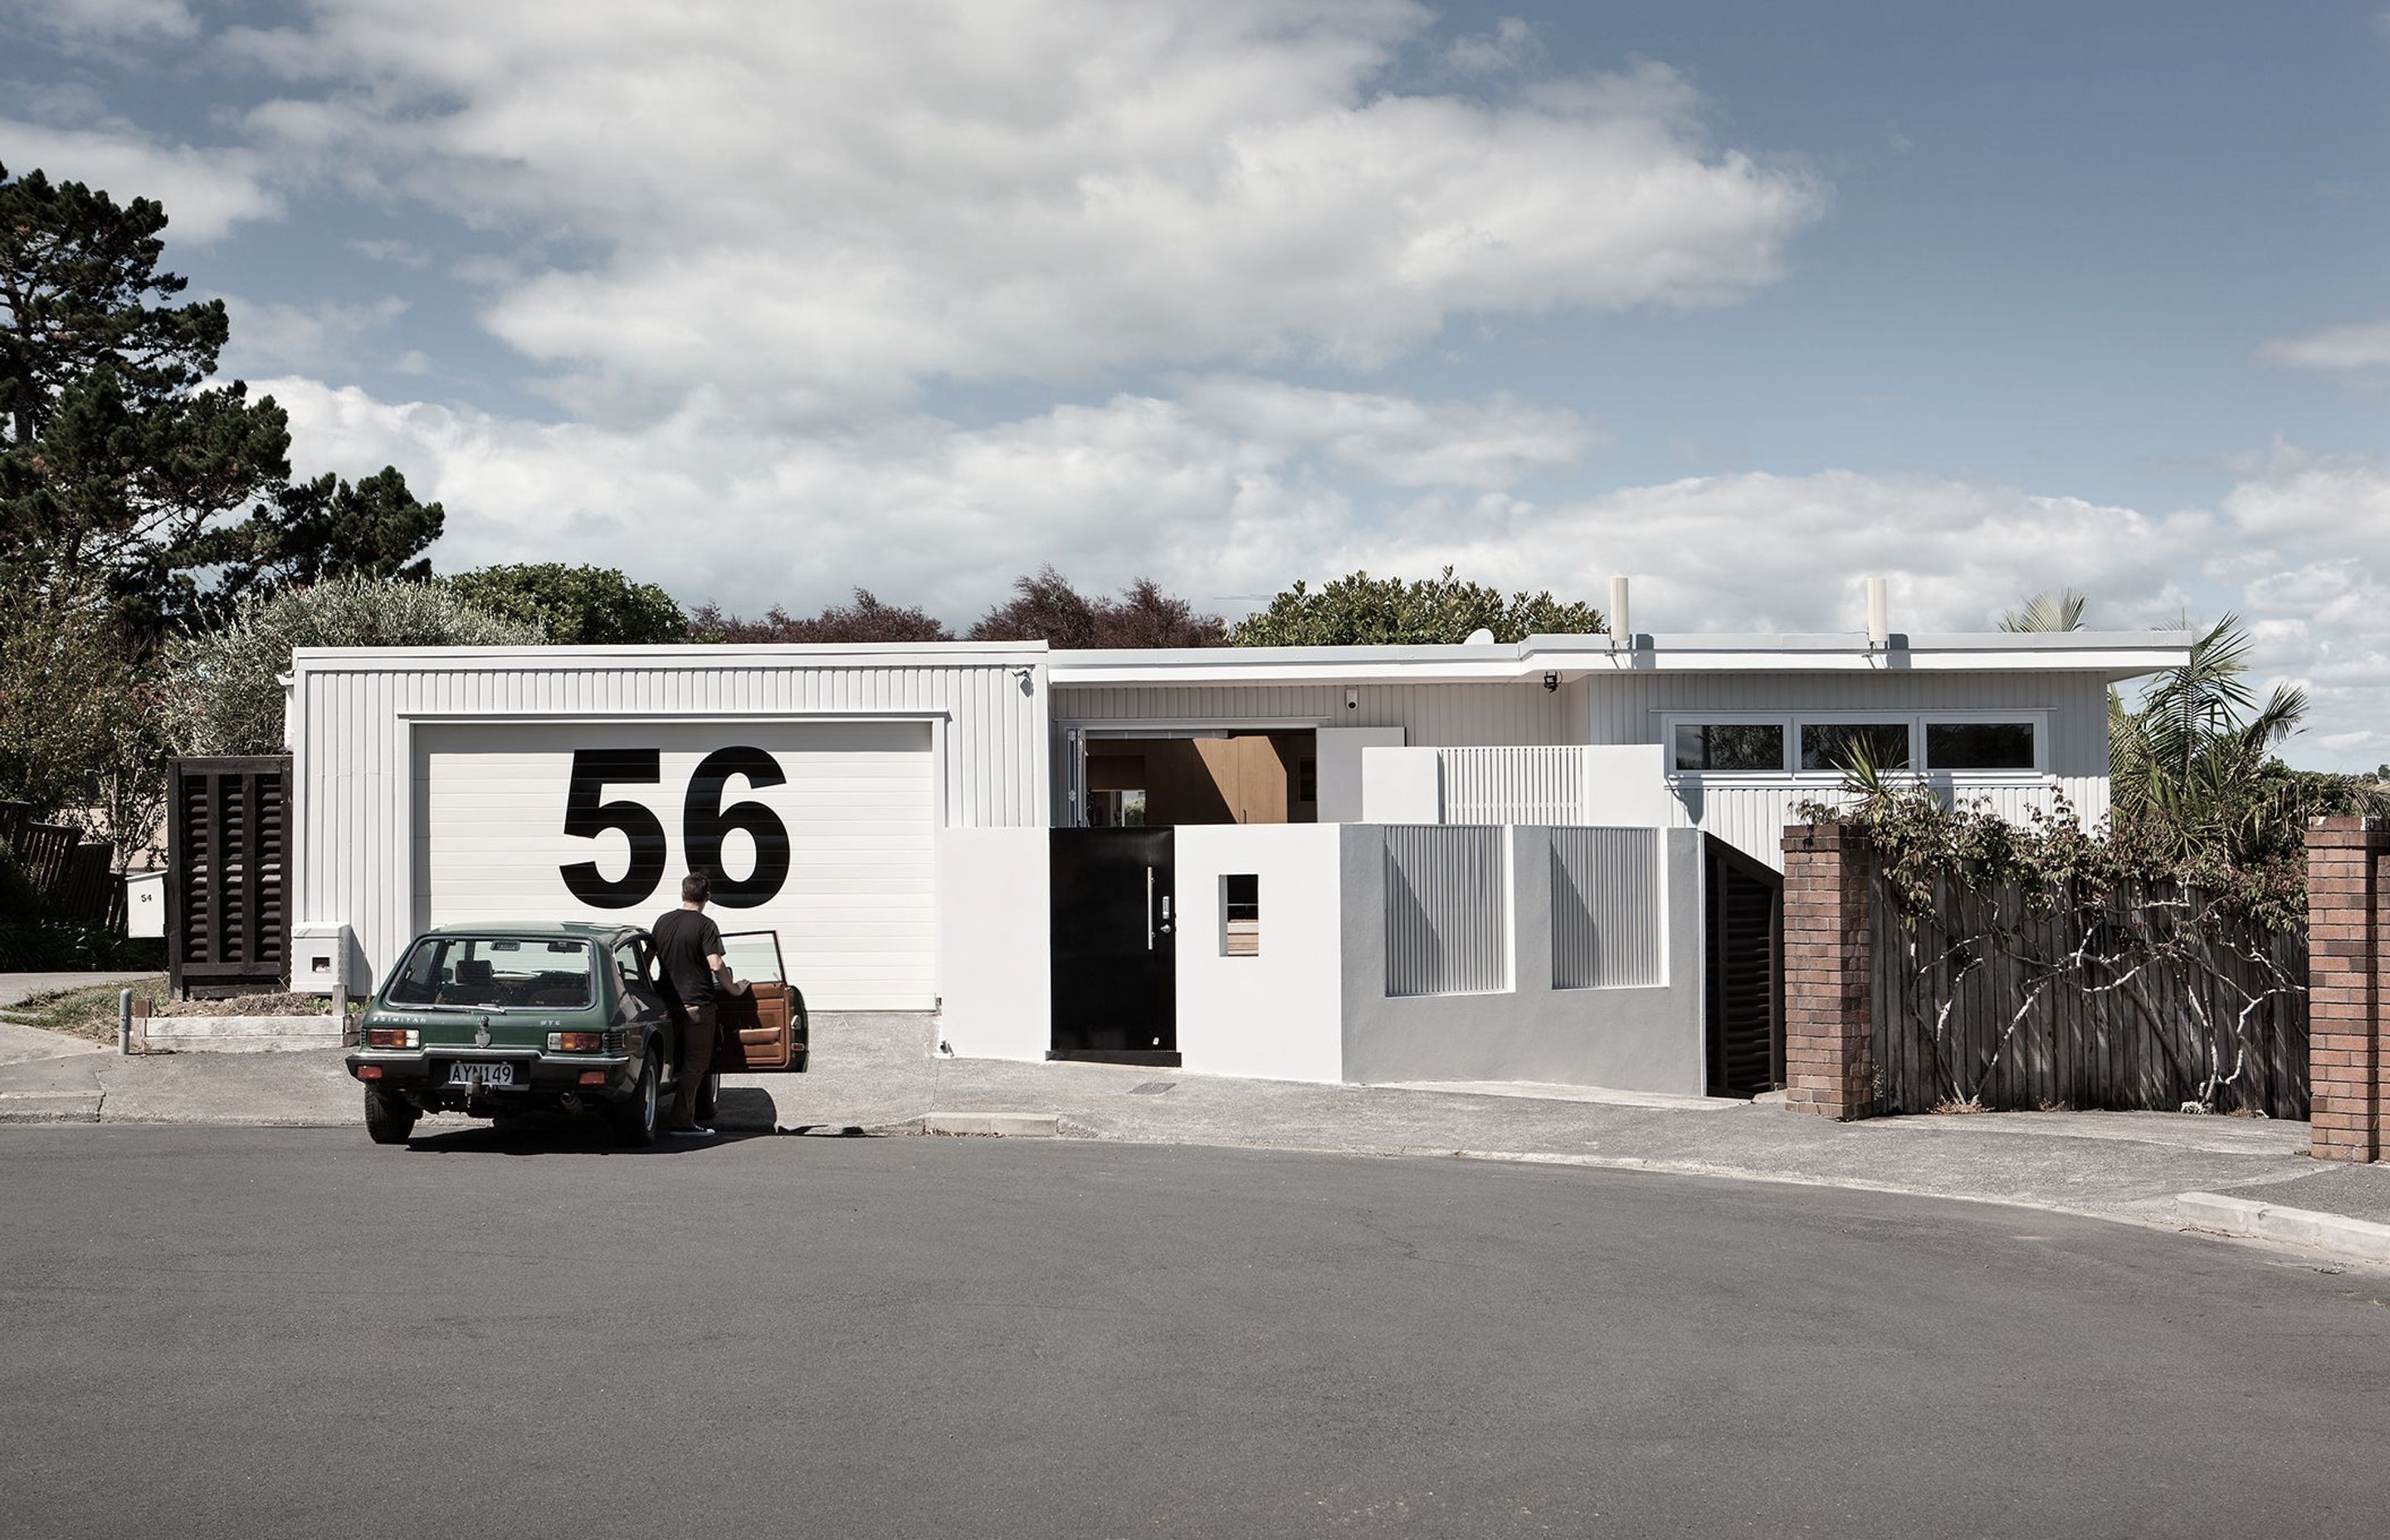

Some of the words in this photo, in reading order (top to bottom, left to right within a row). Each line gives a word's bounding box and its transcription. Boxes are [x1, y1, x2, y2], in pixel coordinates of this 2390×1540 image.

[559, 746, 791, 909] 56
[140, 894, 152, 903] 54
[452, 1065, 511, 1082] AYN149
